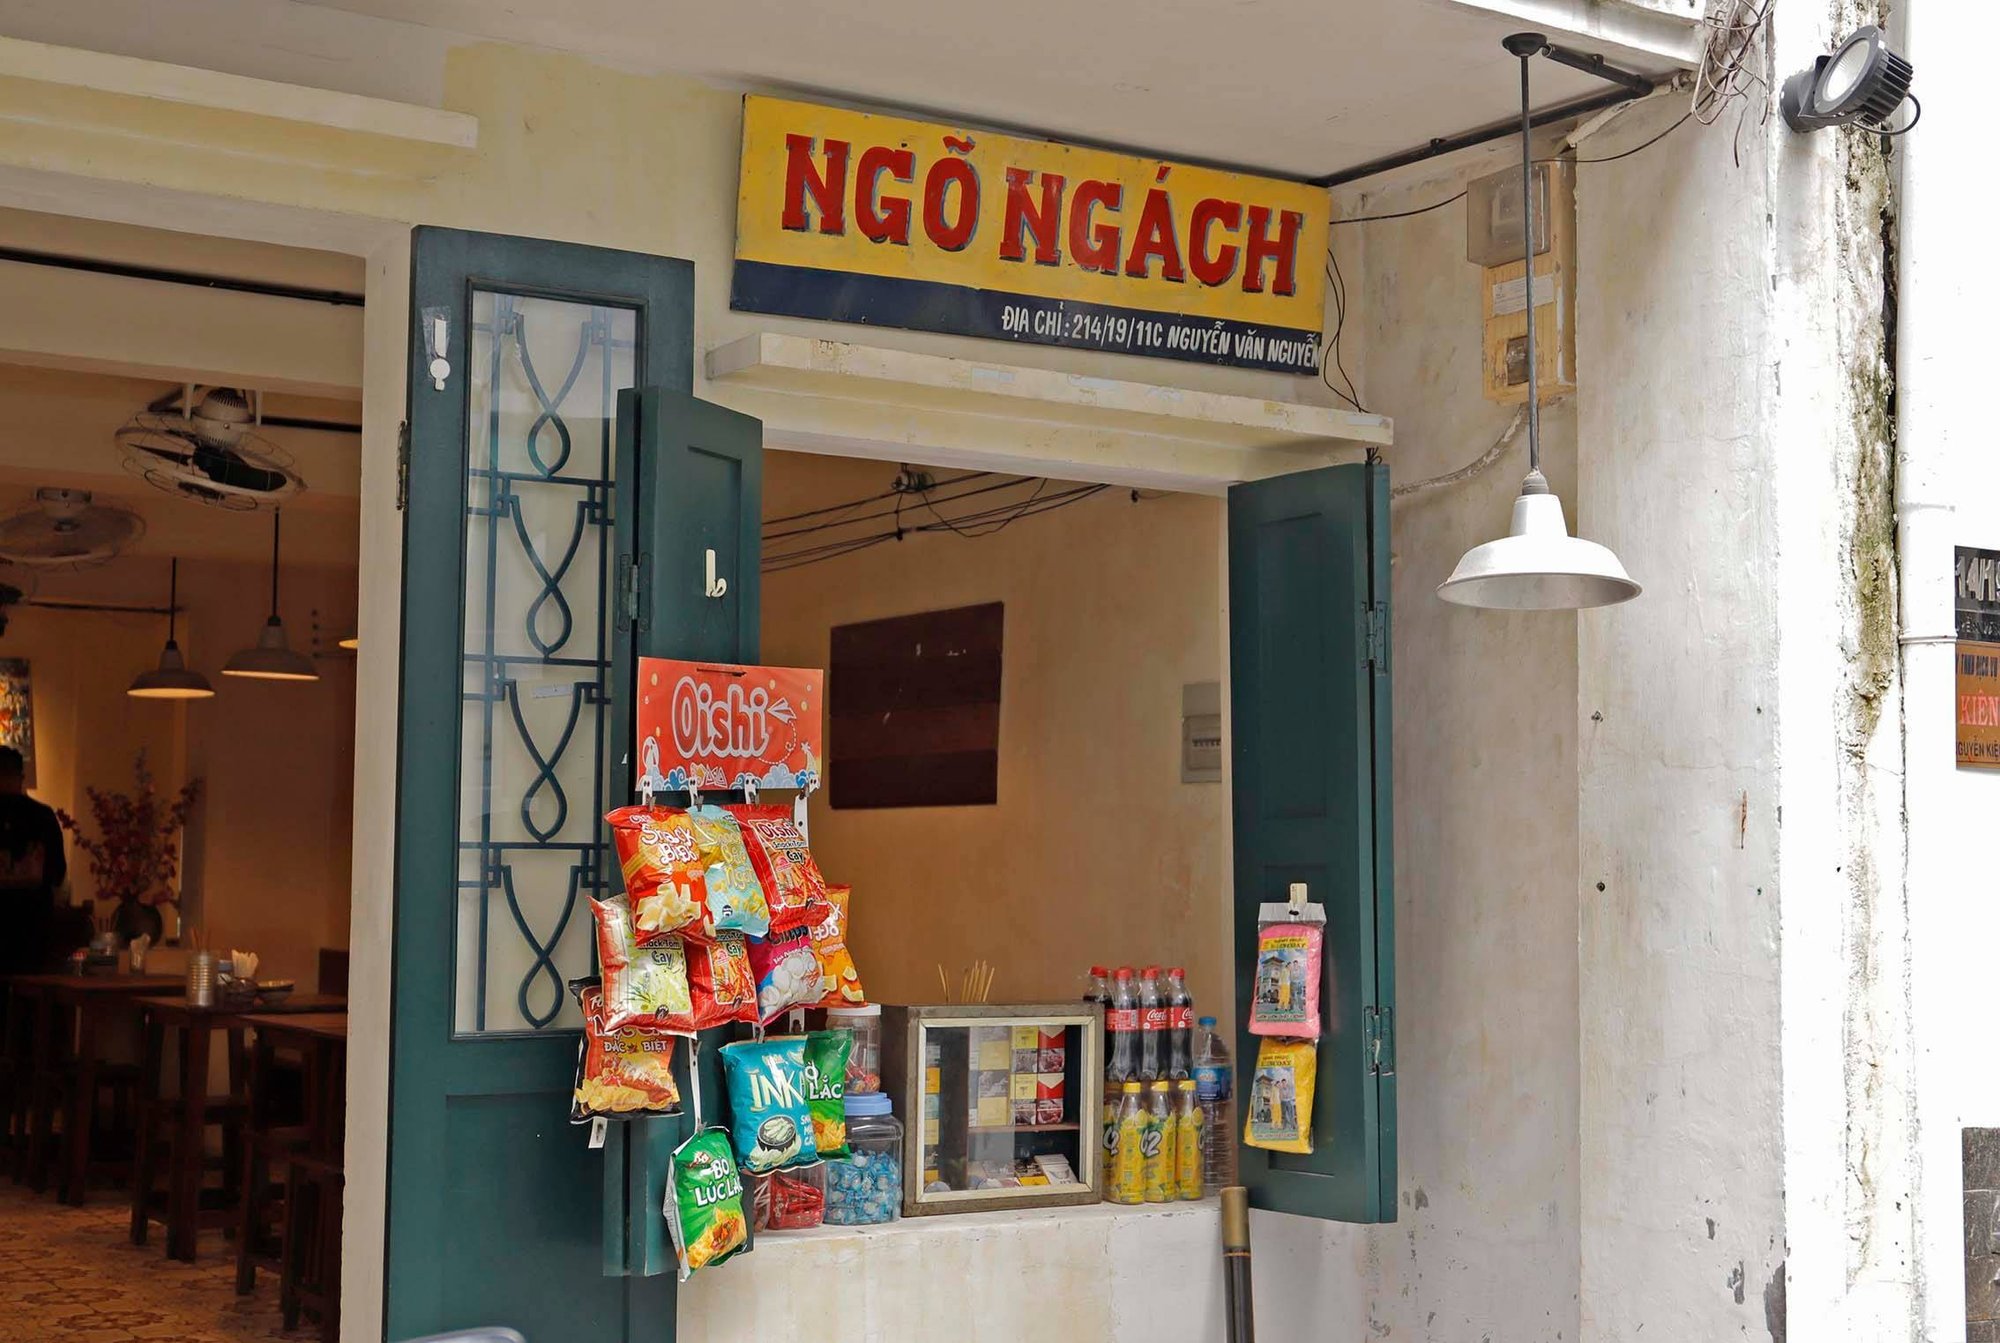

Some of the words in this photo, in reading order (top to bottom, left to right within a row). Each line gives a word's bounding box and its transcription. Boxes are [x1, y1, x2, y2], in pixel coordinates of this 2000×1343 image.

[781, 133, 982, 252] NGÕ
[999, 165, 1304, 297] NGÁCH
[1002, 305, 1029, 338] ĐỊA
[1071, 314, 1163, 349] 214/19/11C
[1167, 321, 1231, 355] NGUYỄN
[1234, 329, 1265, 360] VĂN
[672, 675, 770, 760] Oishi
[651, 950, 674, 969] Cay
